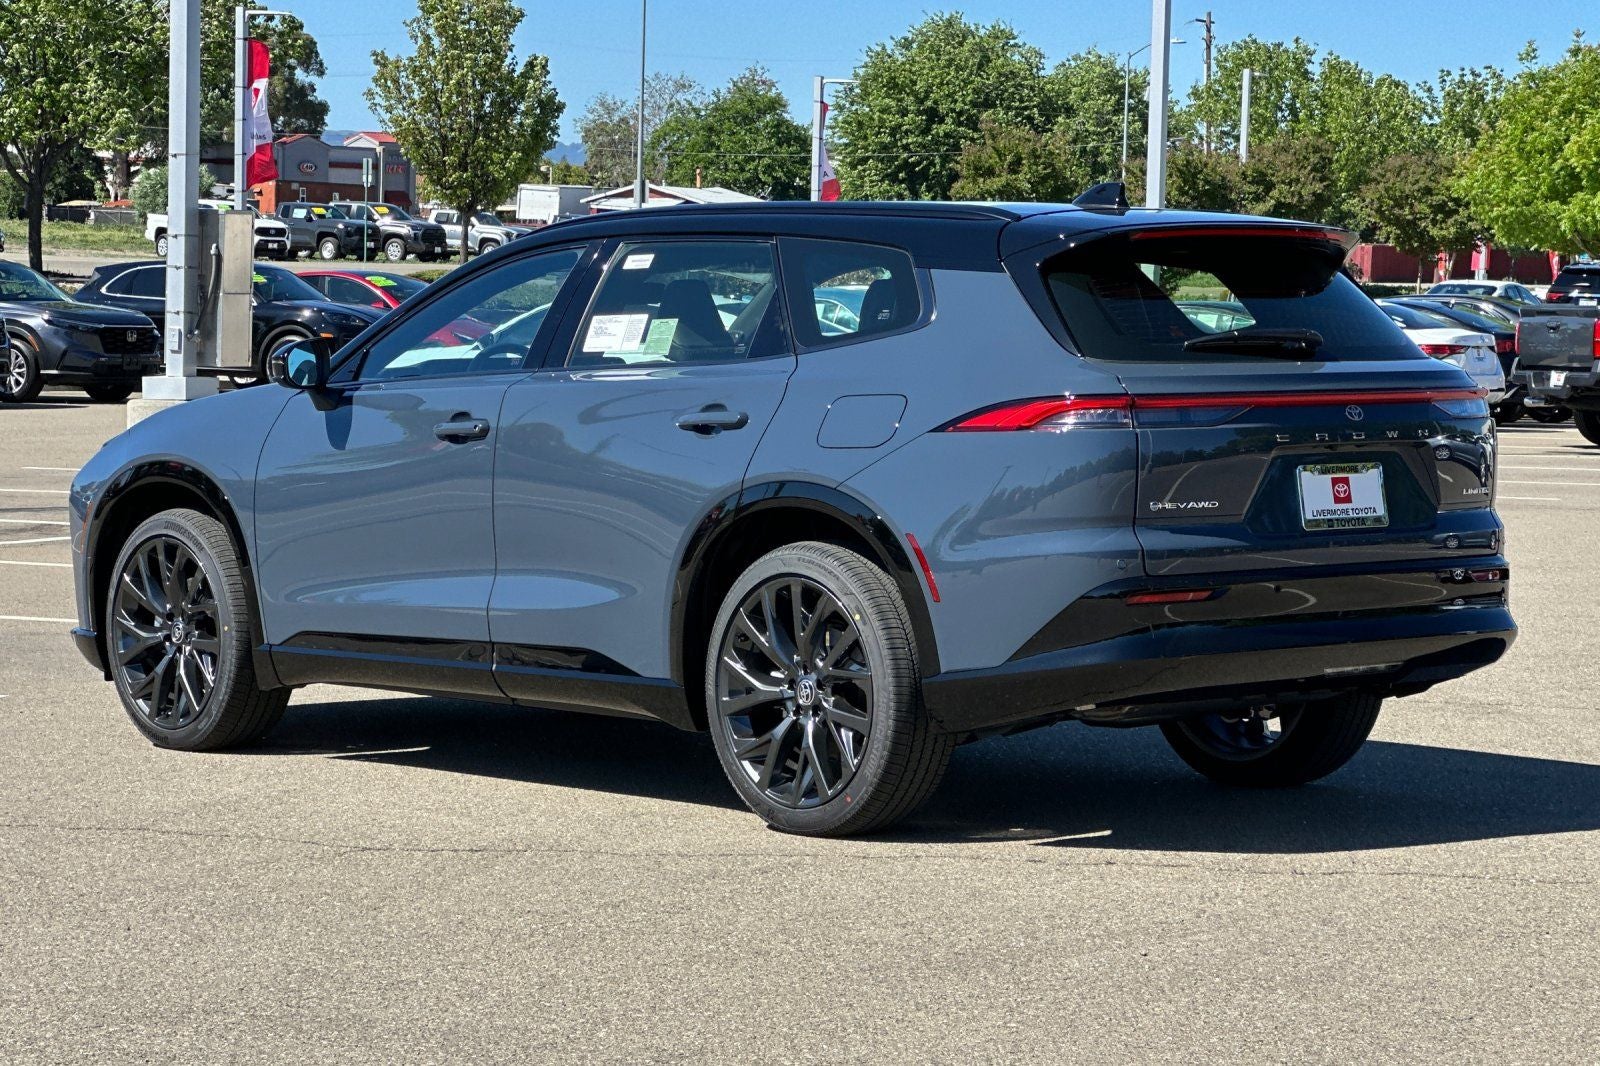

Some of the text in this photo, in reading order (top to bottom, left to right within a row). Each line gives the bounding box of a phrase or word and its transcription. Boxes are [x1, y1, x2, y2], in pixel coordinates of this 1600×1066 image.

[1276, 429, 1429, 442] CROWN
[1321, 464, 1359, 474] LIVERMORE
[1312, 506, 1377, 518] LIVERMORE TOYOTA
[1334, 518, 1367, 528] TOYOTA
